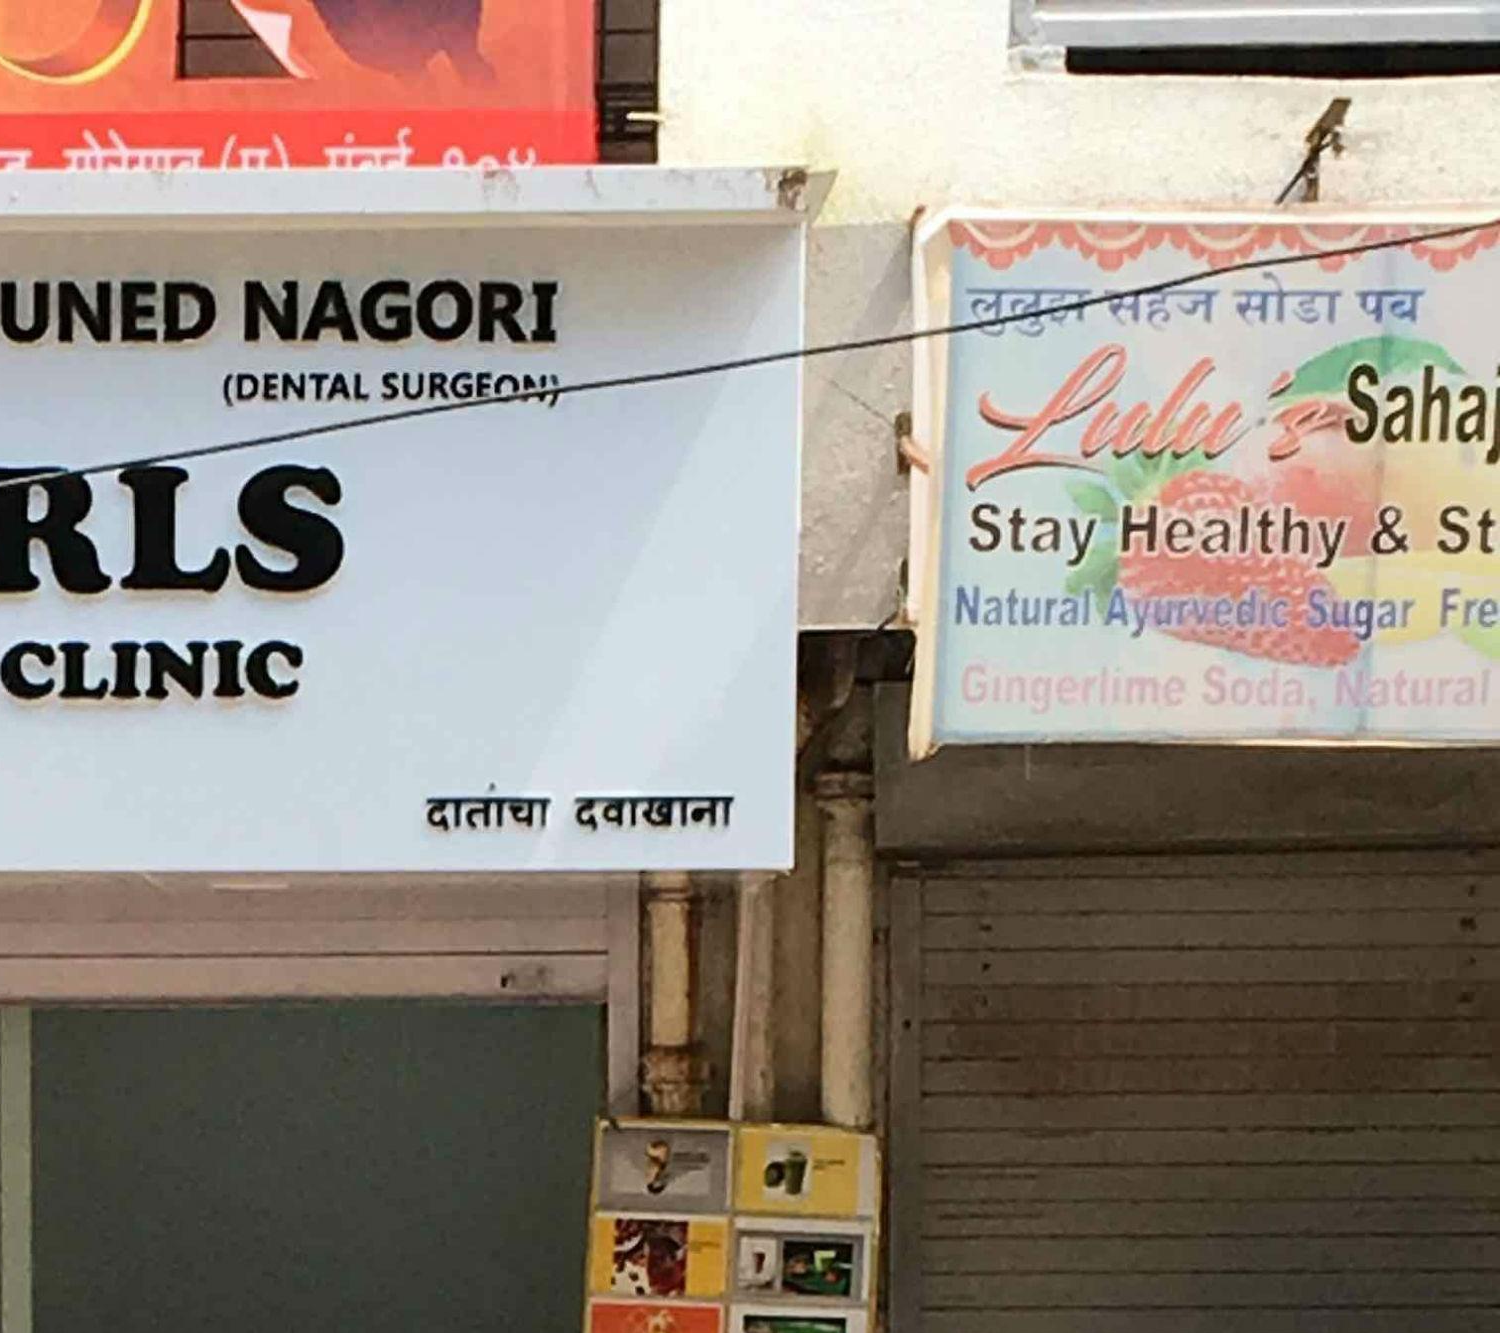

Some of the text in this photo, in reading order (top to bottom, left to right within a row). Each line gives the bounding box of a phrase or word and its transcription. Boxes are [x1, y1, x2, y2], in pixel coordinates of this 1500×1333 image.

[244, 279, 558, 343] NAGORI
[1233, 272, 1342, 325] सोडा
[224, 372, 369, 406] (DENTAL
[969, 504, 1098, 566] Stay
[1121, 504, 1346, 568] Healthy
[1371, 505, 1409, 554] &
[954, 586, 1090, 627] Natural
[1104, 588, 1289, 638] Ayurvedic
[1306, 588, 1416, 640] Sugar
[0, 640, 303, 699] CLINIC
[961, 663, 1491, 713] Gingerlime Soda, Natural
[575, 796, 735, 831] दवाखाना
